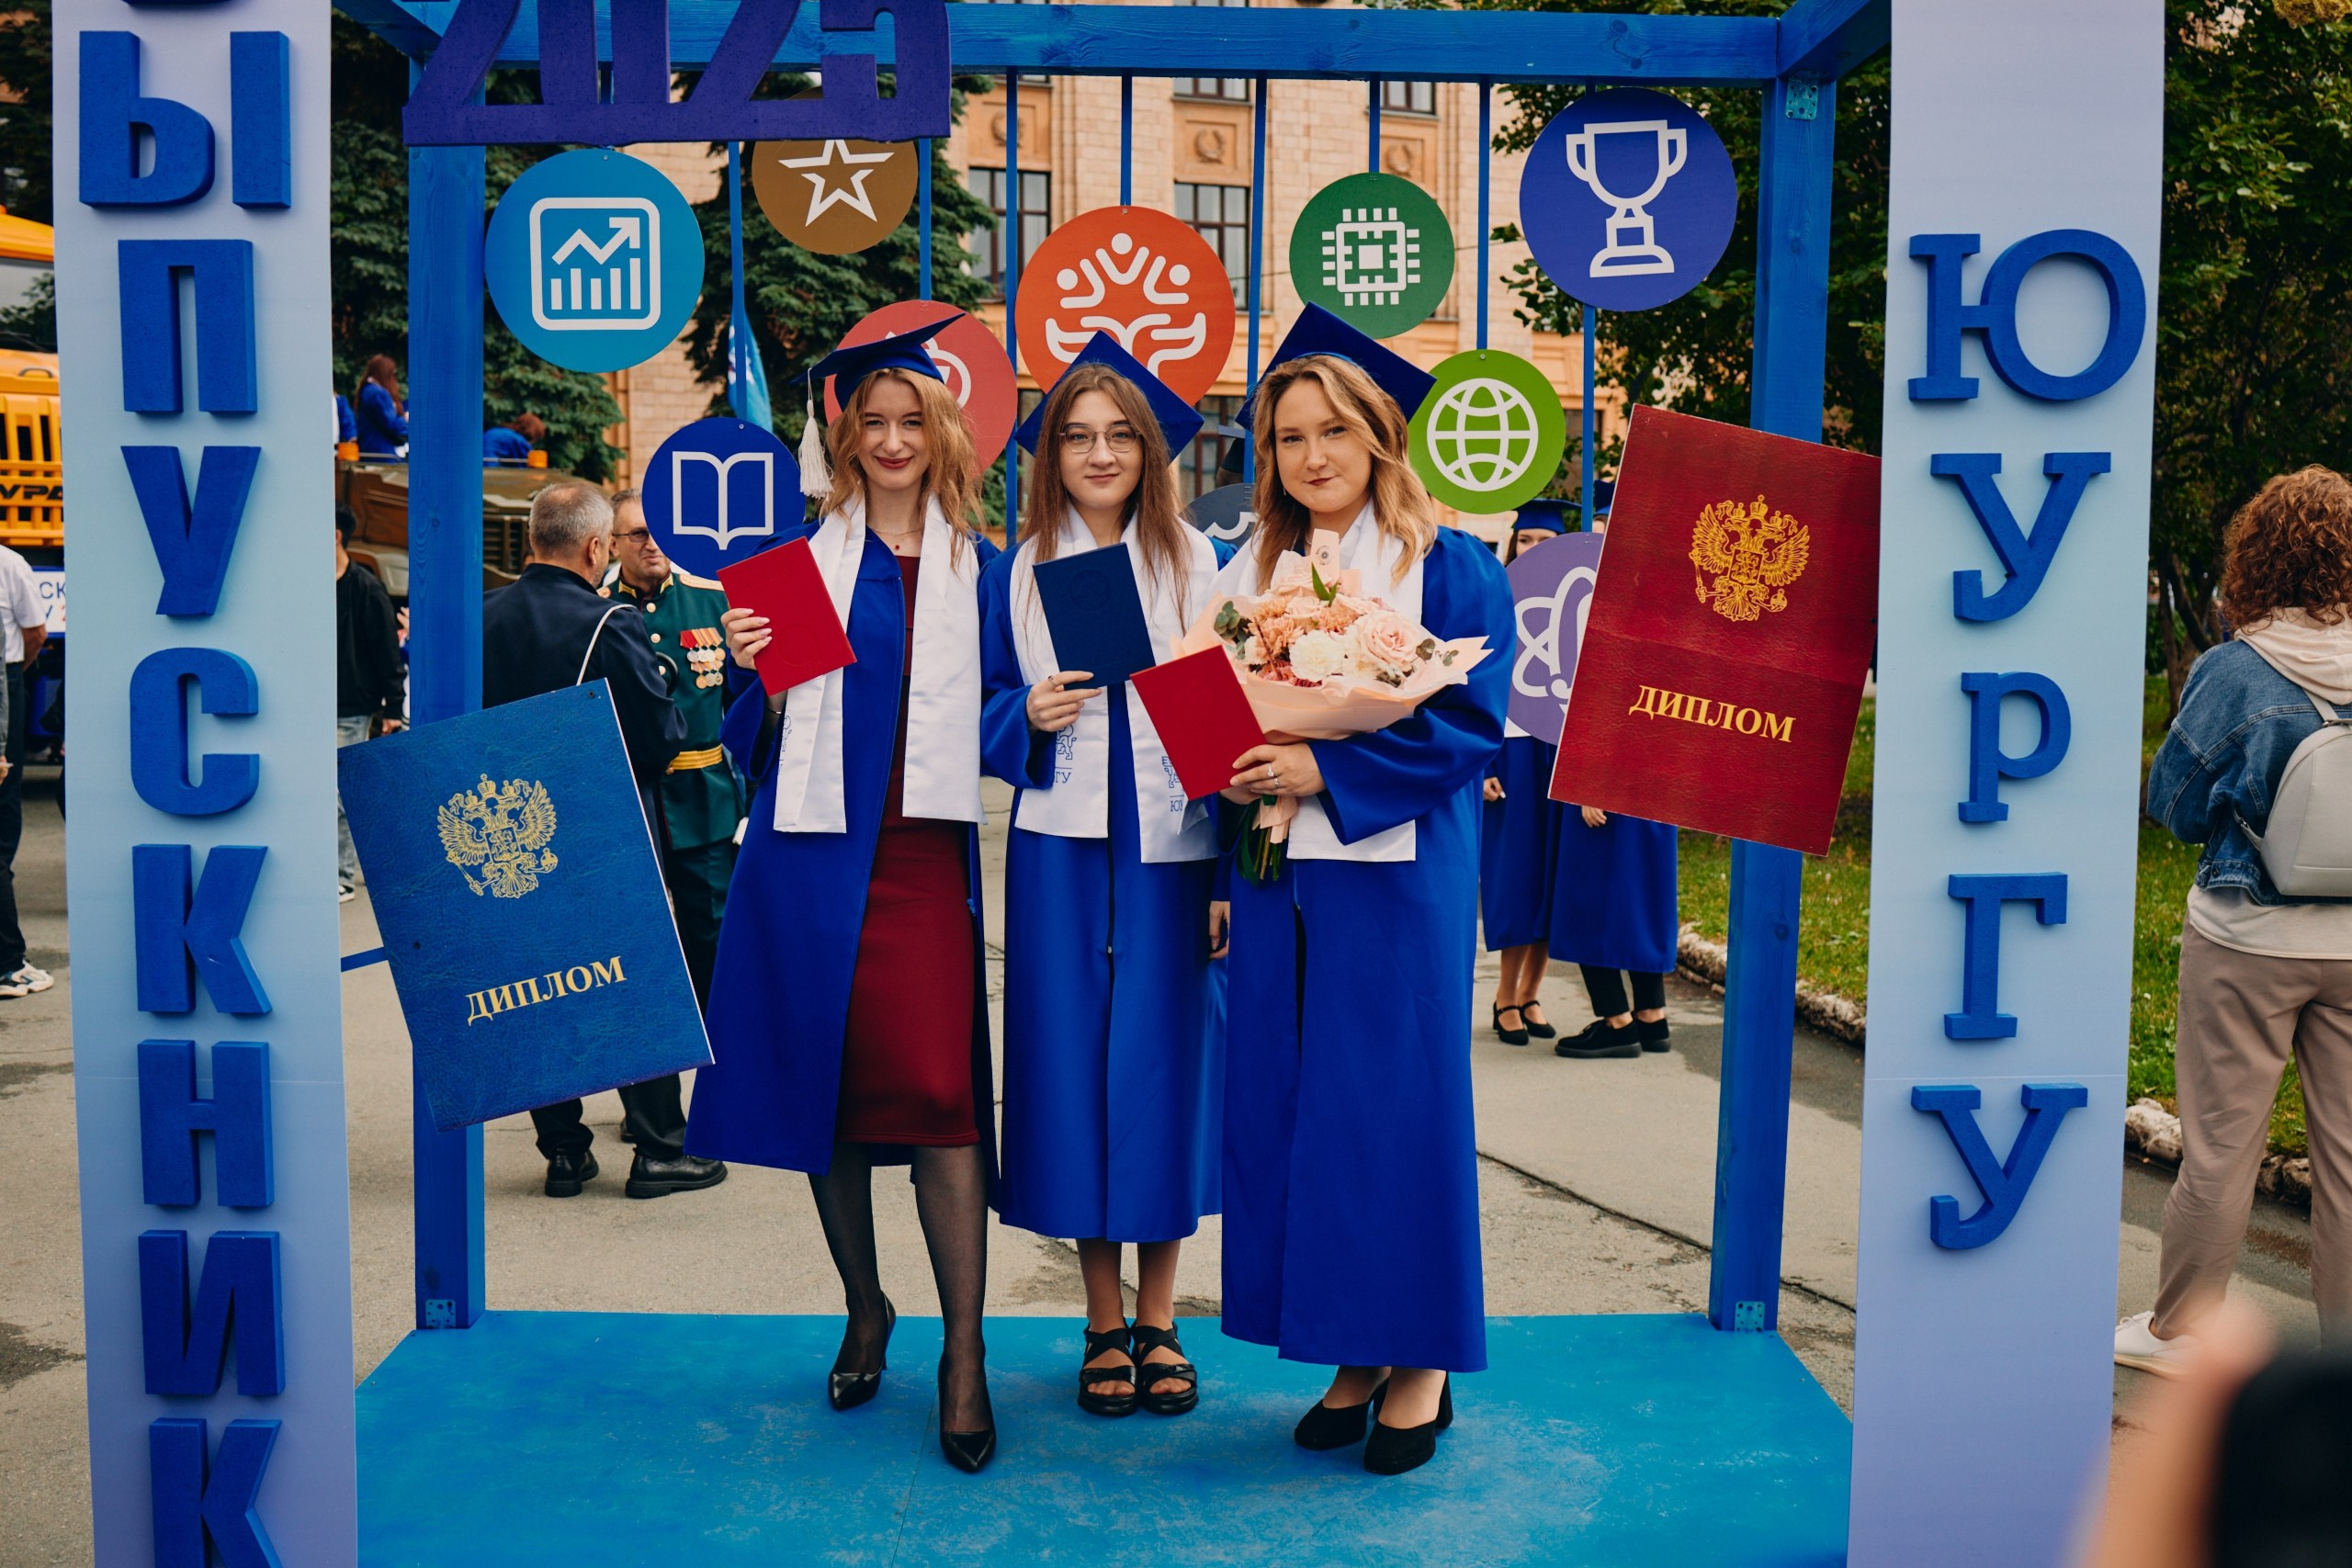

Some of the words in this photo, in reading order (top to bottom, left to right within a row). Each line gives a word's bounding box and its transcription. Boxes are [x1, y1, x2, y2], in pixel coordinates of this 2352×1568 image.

[1628, 685, 1797, 743] ДИПЛОМ
[78, 0, 291, 1568] ЫПУСКНИК
[464, 955, 628, 1027] ДИПЛОМ
